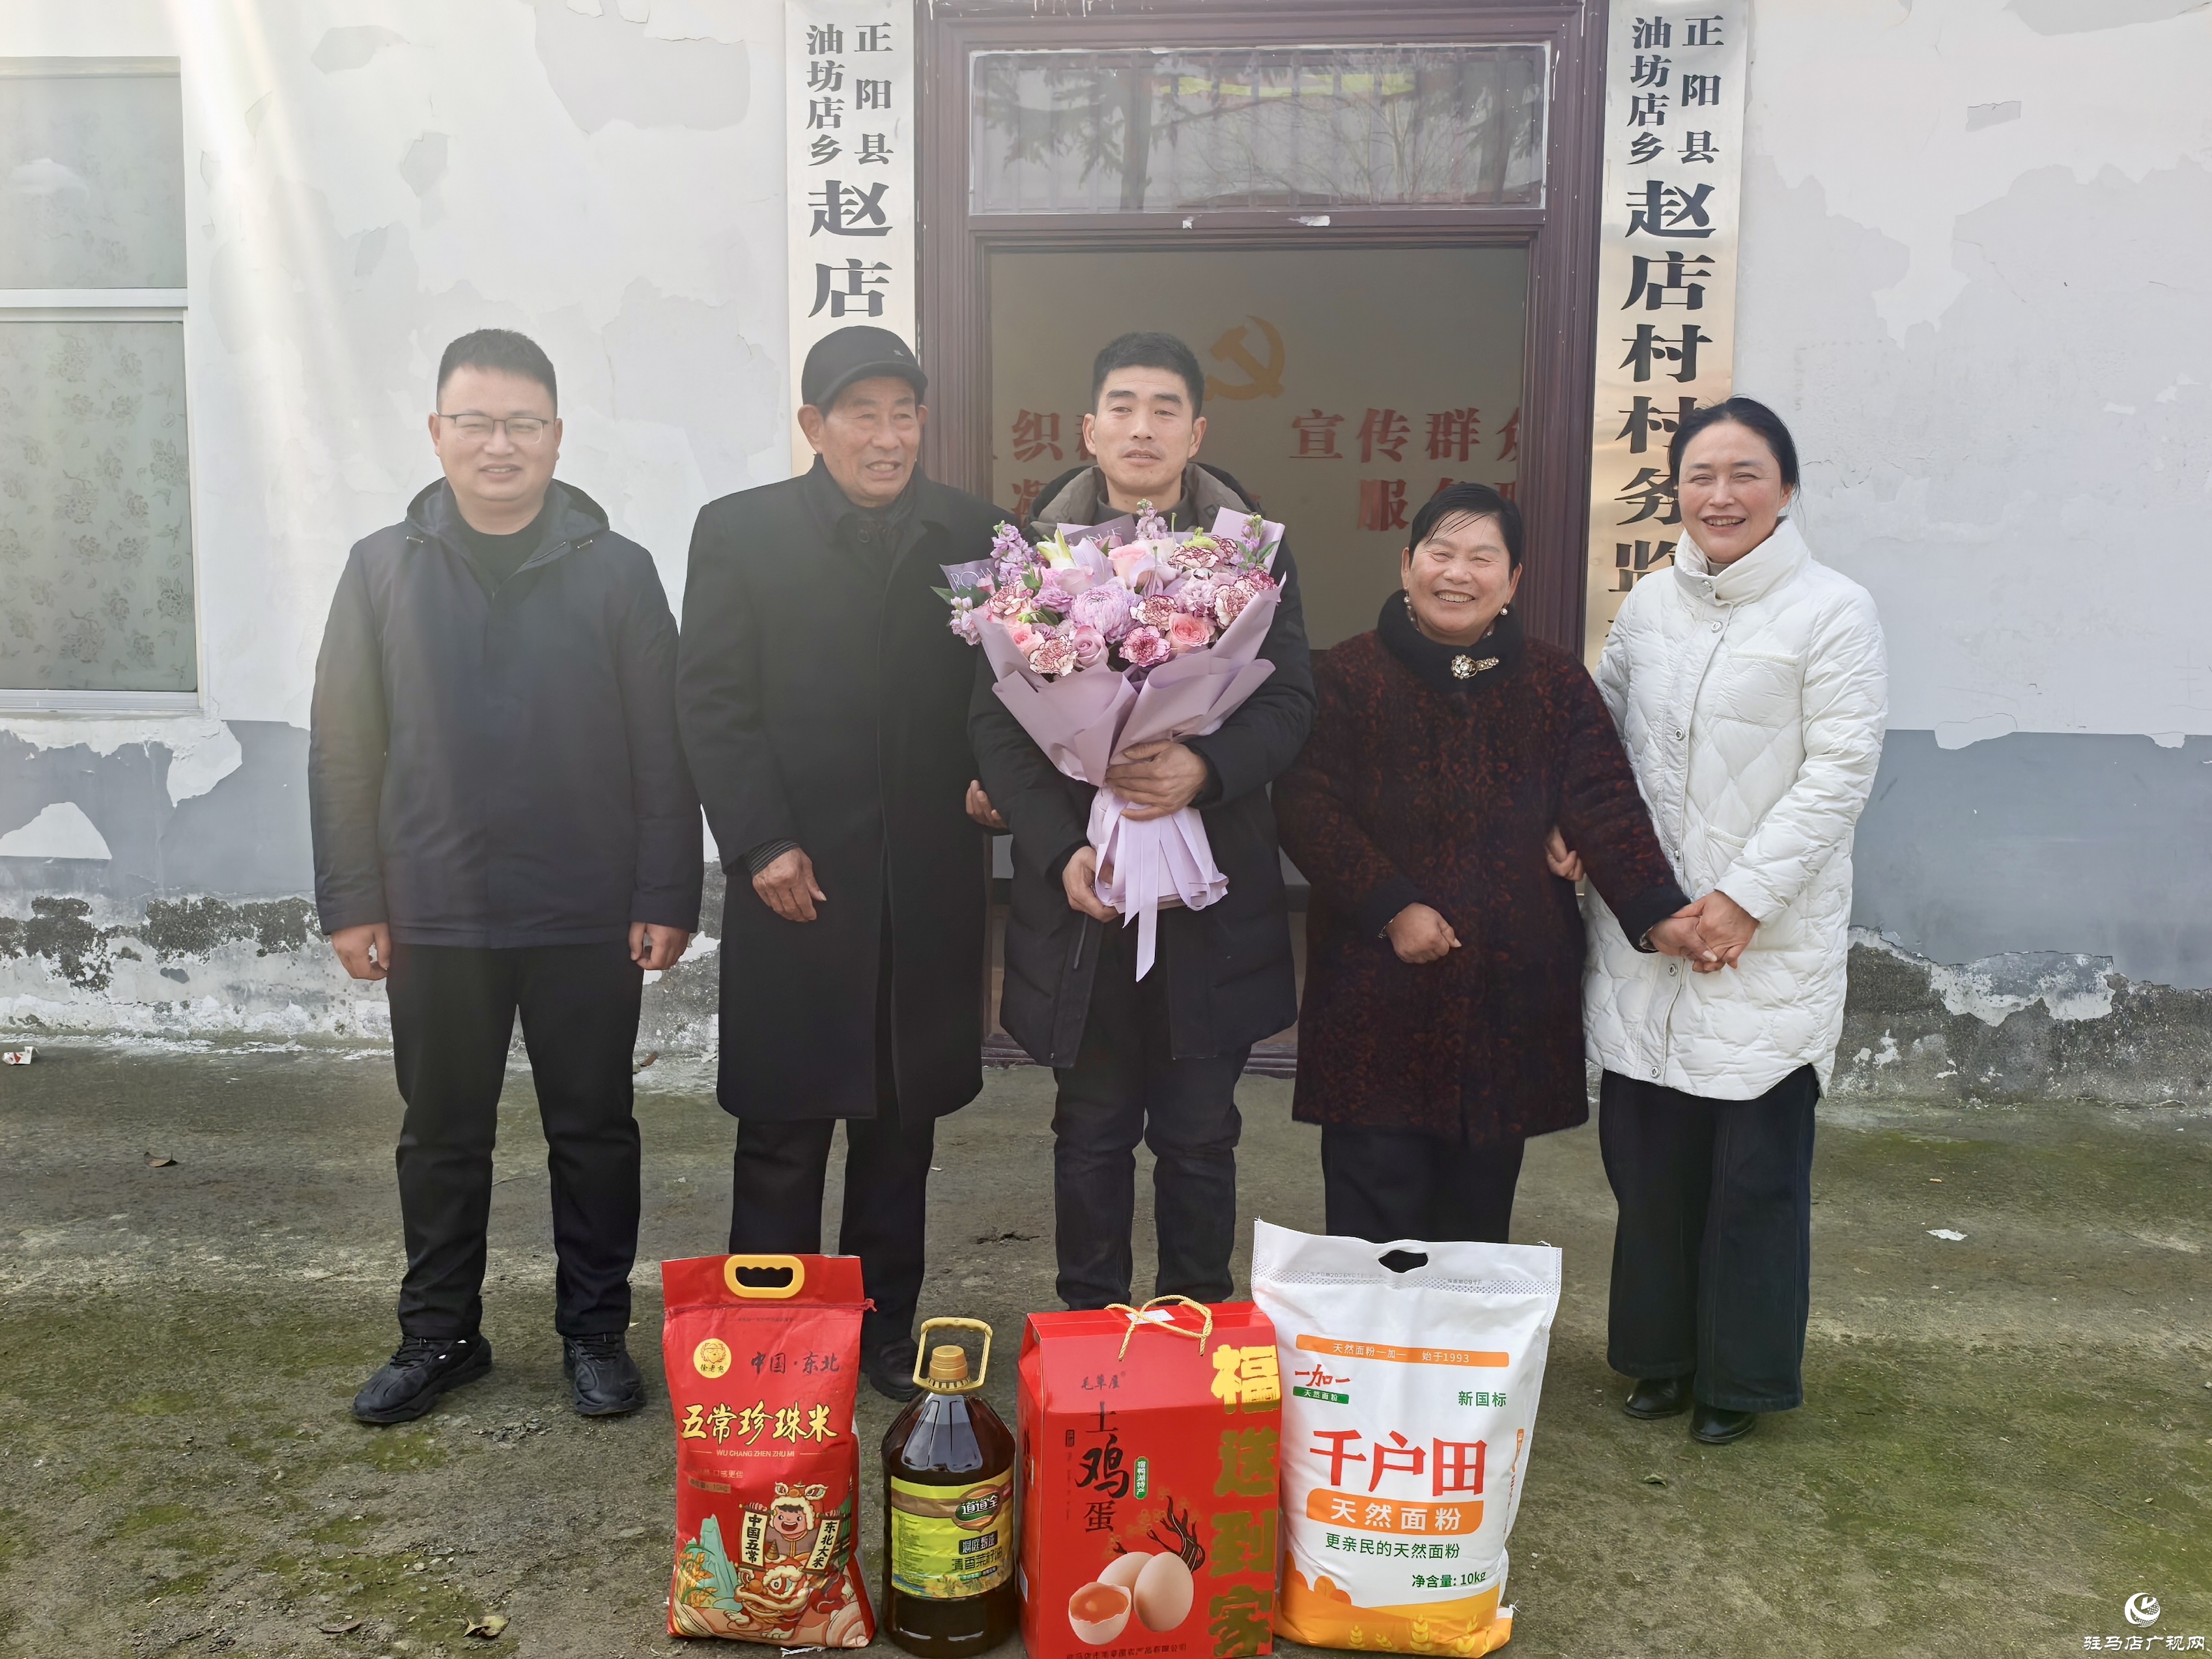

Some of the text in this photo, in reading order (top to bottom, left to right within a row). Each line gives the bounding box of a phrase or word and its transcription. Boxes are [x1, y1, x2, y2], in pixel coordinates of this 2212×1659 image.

[806, 23, 845, 166] 油坊店乡
[854, 23, 893, 165] 正阳县
[1626, 16, 1671, 164] 油坊店乡
[1678, 16, 1724, 163] 正阳县
[808, 180, 893, 318] 赵店
[1606, 180, 1716, 637] 赵店村村务监
[1295, 1364, 1350, 1387] 一加一
[1422, 1350, 1469, 1363] 始于1993
[1303, 1389, 1339, 1402] 天然面粉
[1458, 1391, 1507, 1408] 新国标
[681, 1400, 839, 1446] 五常珍珠米
[1075, 1401, 1129, 1533] 土鸡蛋
[1309, 1430, 1487, 1497] 千户田
[961, 1495, 999, 1515] 道道全
[1208, 1344, 1281, 1657] 福送到家
[1330, 1497, 1461, 1531] 天然面粉
[745, 1514, 762, 1563] 中国五常
[812, 1521, 838, 1568] 东北大米
[952, 1546, 1003, 1571] 清香菜籽油
[1326, 1532, 1460, 1559] 更亲民的天然面粉
[1460, 1571, 1486, 1585] 10kg
